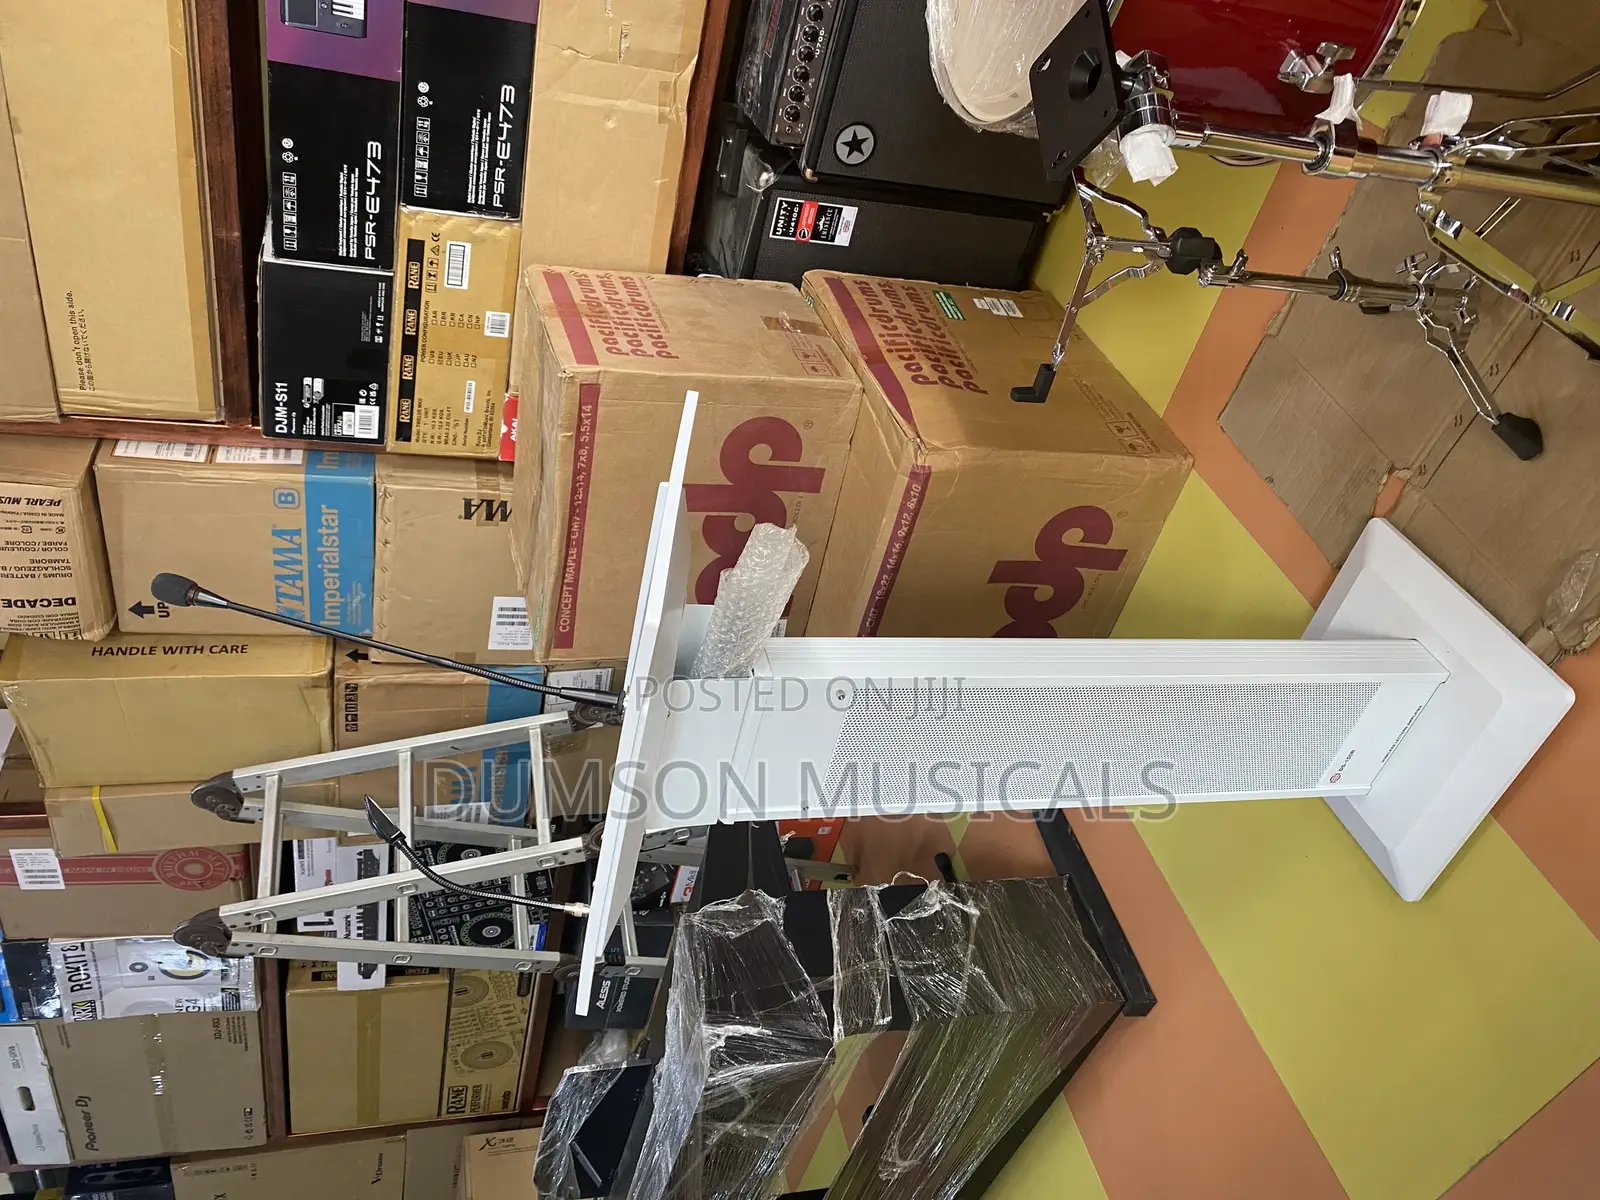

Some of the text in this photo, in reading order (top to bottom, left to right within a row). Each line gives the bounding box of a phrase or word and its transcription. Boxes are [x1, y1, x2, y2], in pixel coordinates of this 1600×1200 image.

[493, 84, 515, 207] PSR-E473
[365, 141, 382, 260] PSR-E473
[776, 202, 788, 235] UNITY
[408, 262, 420, 289] RANE
[405, 309, 417, 336] RANE
[421, 300, 430, 343] CONFIGURATION
[432, 310, 438, 320] AR
[450, 312, 456, 321] KR
[459, 313, 464, 322] CA
[467, 314, 473, 323] CN
[475, 315, 481, 324] NP
[572, 273, 630, 356] pacificdrums
[596, 273, 654, 358] pacificdrums
[618, 276, 680, 359] pacificdrums
[65, 290, 87, 391] Please don't open this side.
[852, 280, 939, 386] pacificdrums
[876, 281, 964, 390] pacificdrums
[900, 285, 988, 395] pacificdrums
[429, 350, 435, 359] US
[438, 351, 444, 360] EU
[447, 352, 453, 360] UK
[455, 353, 461, 362] JP
[464, 353, 470, 362] AU
[471, 354, 477, 363] NZ
[402, 355, 414, 380] RANE
[275, 382, 288, 434] DJM-S11
[399, 399, 411, 423] RANE
[510, 418, 518, 442] AKAI
[580, 405, 592, 442] 5.5x14
[576, 446, 589, 469] 7x8,
[24, 497, 62, 507] PEARL
[278, 492, 296, 505] B
[897, 512, 914, 537] 9x12,
[906, 483, 922, 510] 8x10
[272, 528, 305, 606] TAMA
[317, 504, 344, 626] Imperialstar
[564, 547, 578, 583] MAPLE
[1, 596, 76, 608] DECADE
[157, 601, 171, 618] UP
[559, 584, 574, 632] CONCEPT
[91, 644, 249, 657] HANDLE WITH CARE
[343, 914, 351, 939] Numark
[62, 953, 92, 993] ROKIT
[175, 998, 183, 1013] NEW
[185, 998, 201, 1013] G4
[596, 980, 611, 1009] ALESIS
[615, 991, 627, 1012] POWERED
[72, 1002, 94, 1021] KRK
[212, 1018, 222, 1040] XDJ-RX3
[446, 1085, 469, 1115] RANE
[470, 1084, 483, 1113] PERFORMER
[82, 1110, 99, 1152] Pioneer
